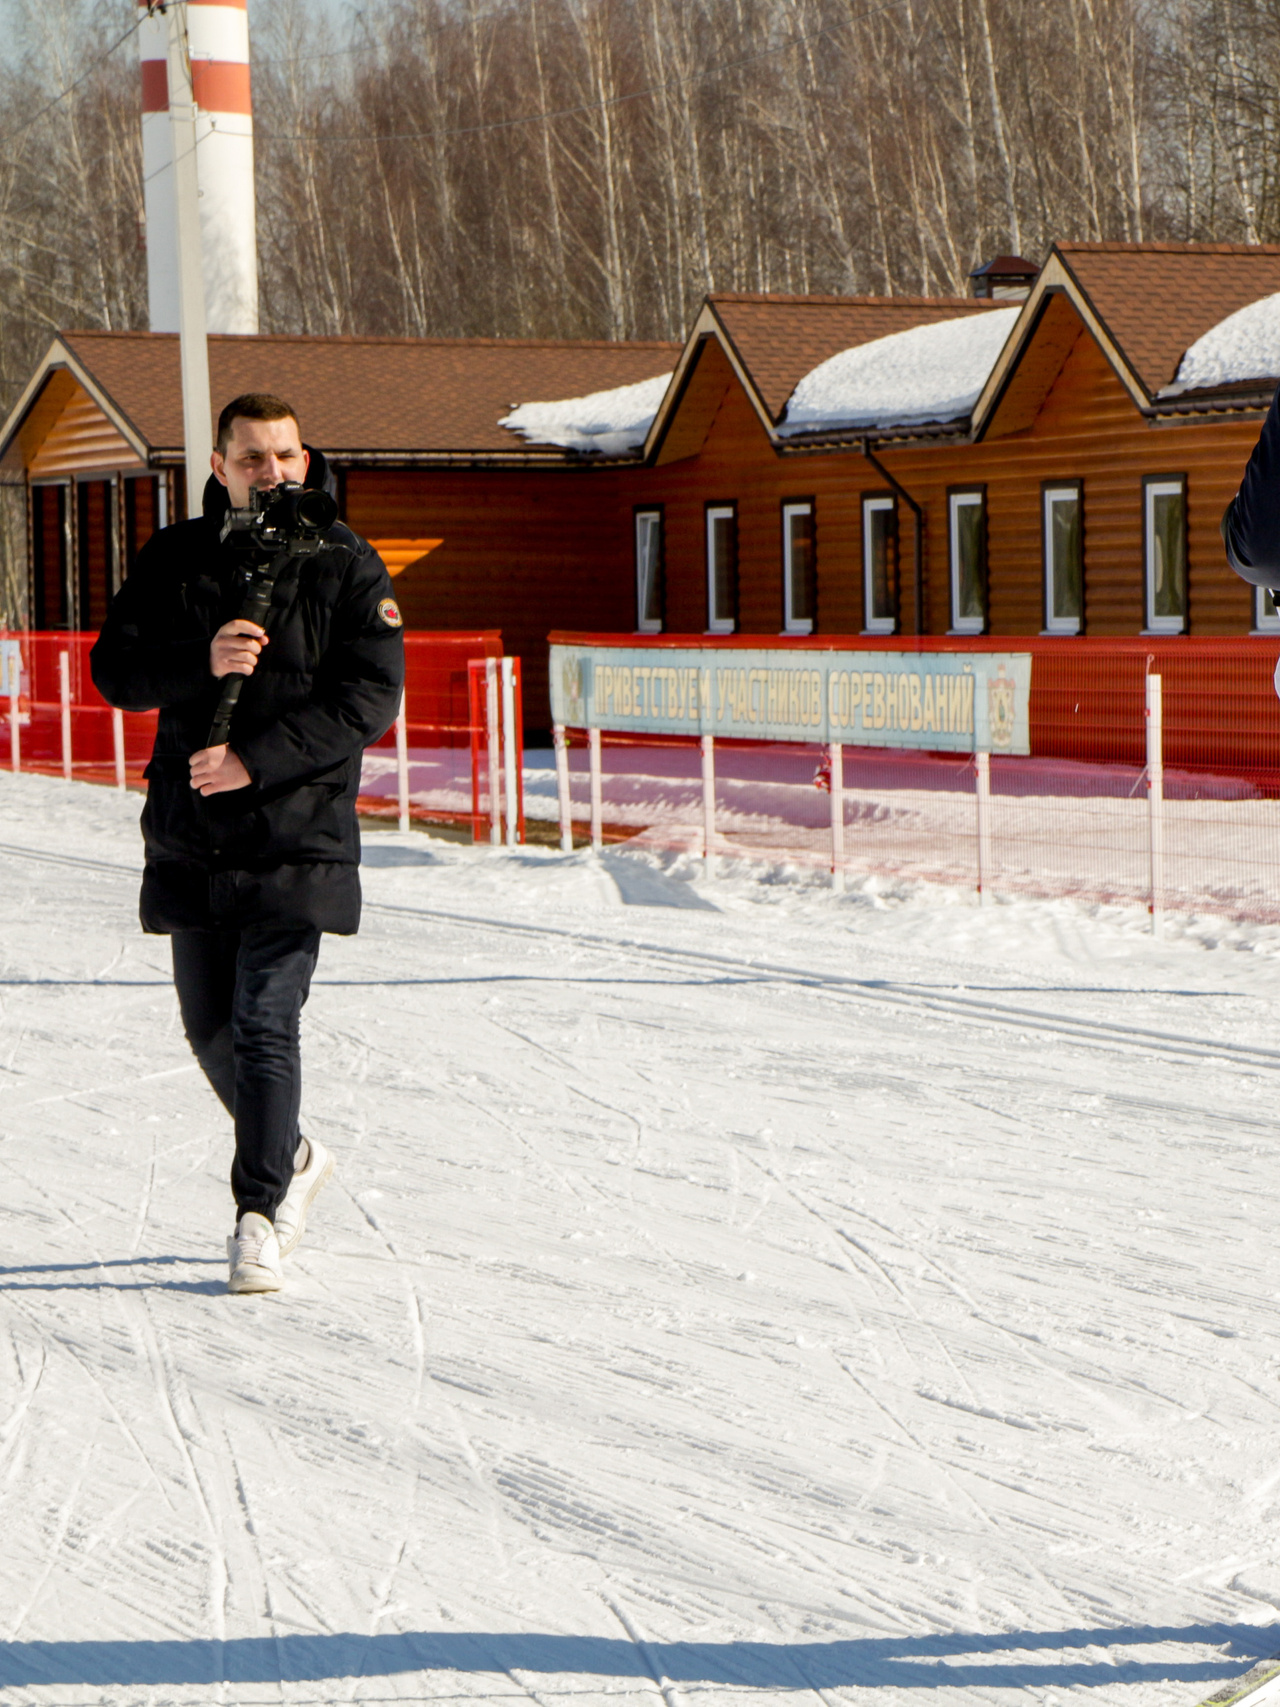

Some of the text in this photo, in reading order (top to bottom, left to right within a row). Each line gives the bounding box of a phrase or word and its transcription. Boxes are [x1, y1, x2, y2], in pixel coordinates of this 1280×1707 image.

[594, 663, 975, 735] ПРИВЕТСТВУЕМ УЧАСТНИКОВ СОРЕВНОВАНИЙ
